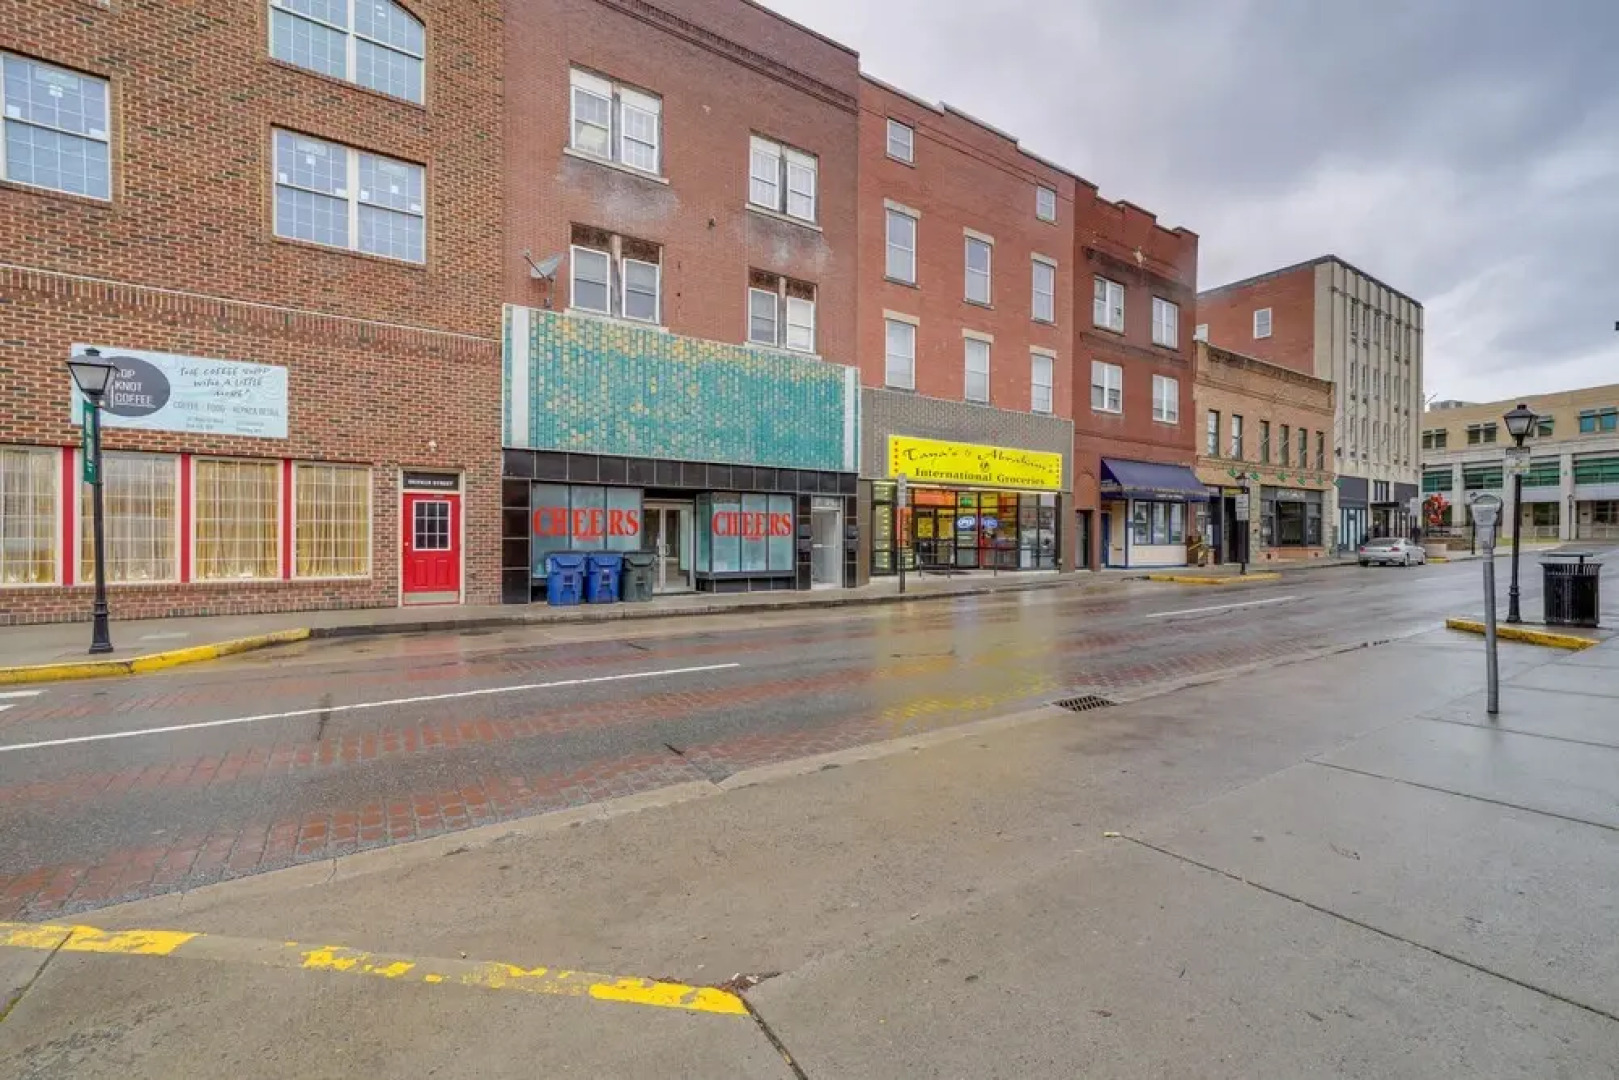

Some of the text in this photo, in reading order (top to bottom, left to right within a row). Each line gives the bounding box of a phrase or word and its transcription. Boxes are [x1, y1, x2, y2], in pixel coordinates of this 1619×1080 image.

[114, 381, 142, 392] KNOT
[114, 393, 152, 404] COFFEE
[915, 467, 1045, 485] International Groceries
[533, 506, 639, 537] CHEERS
[711, 511, 793, 537] CHEERS
